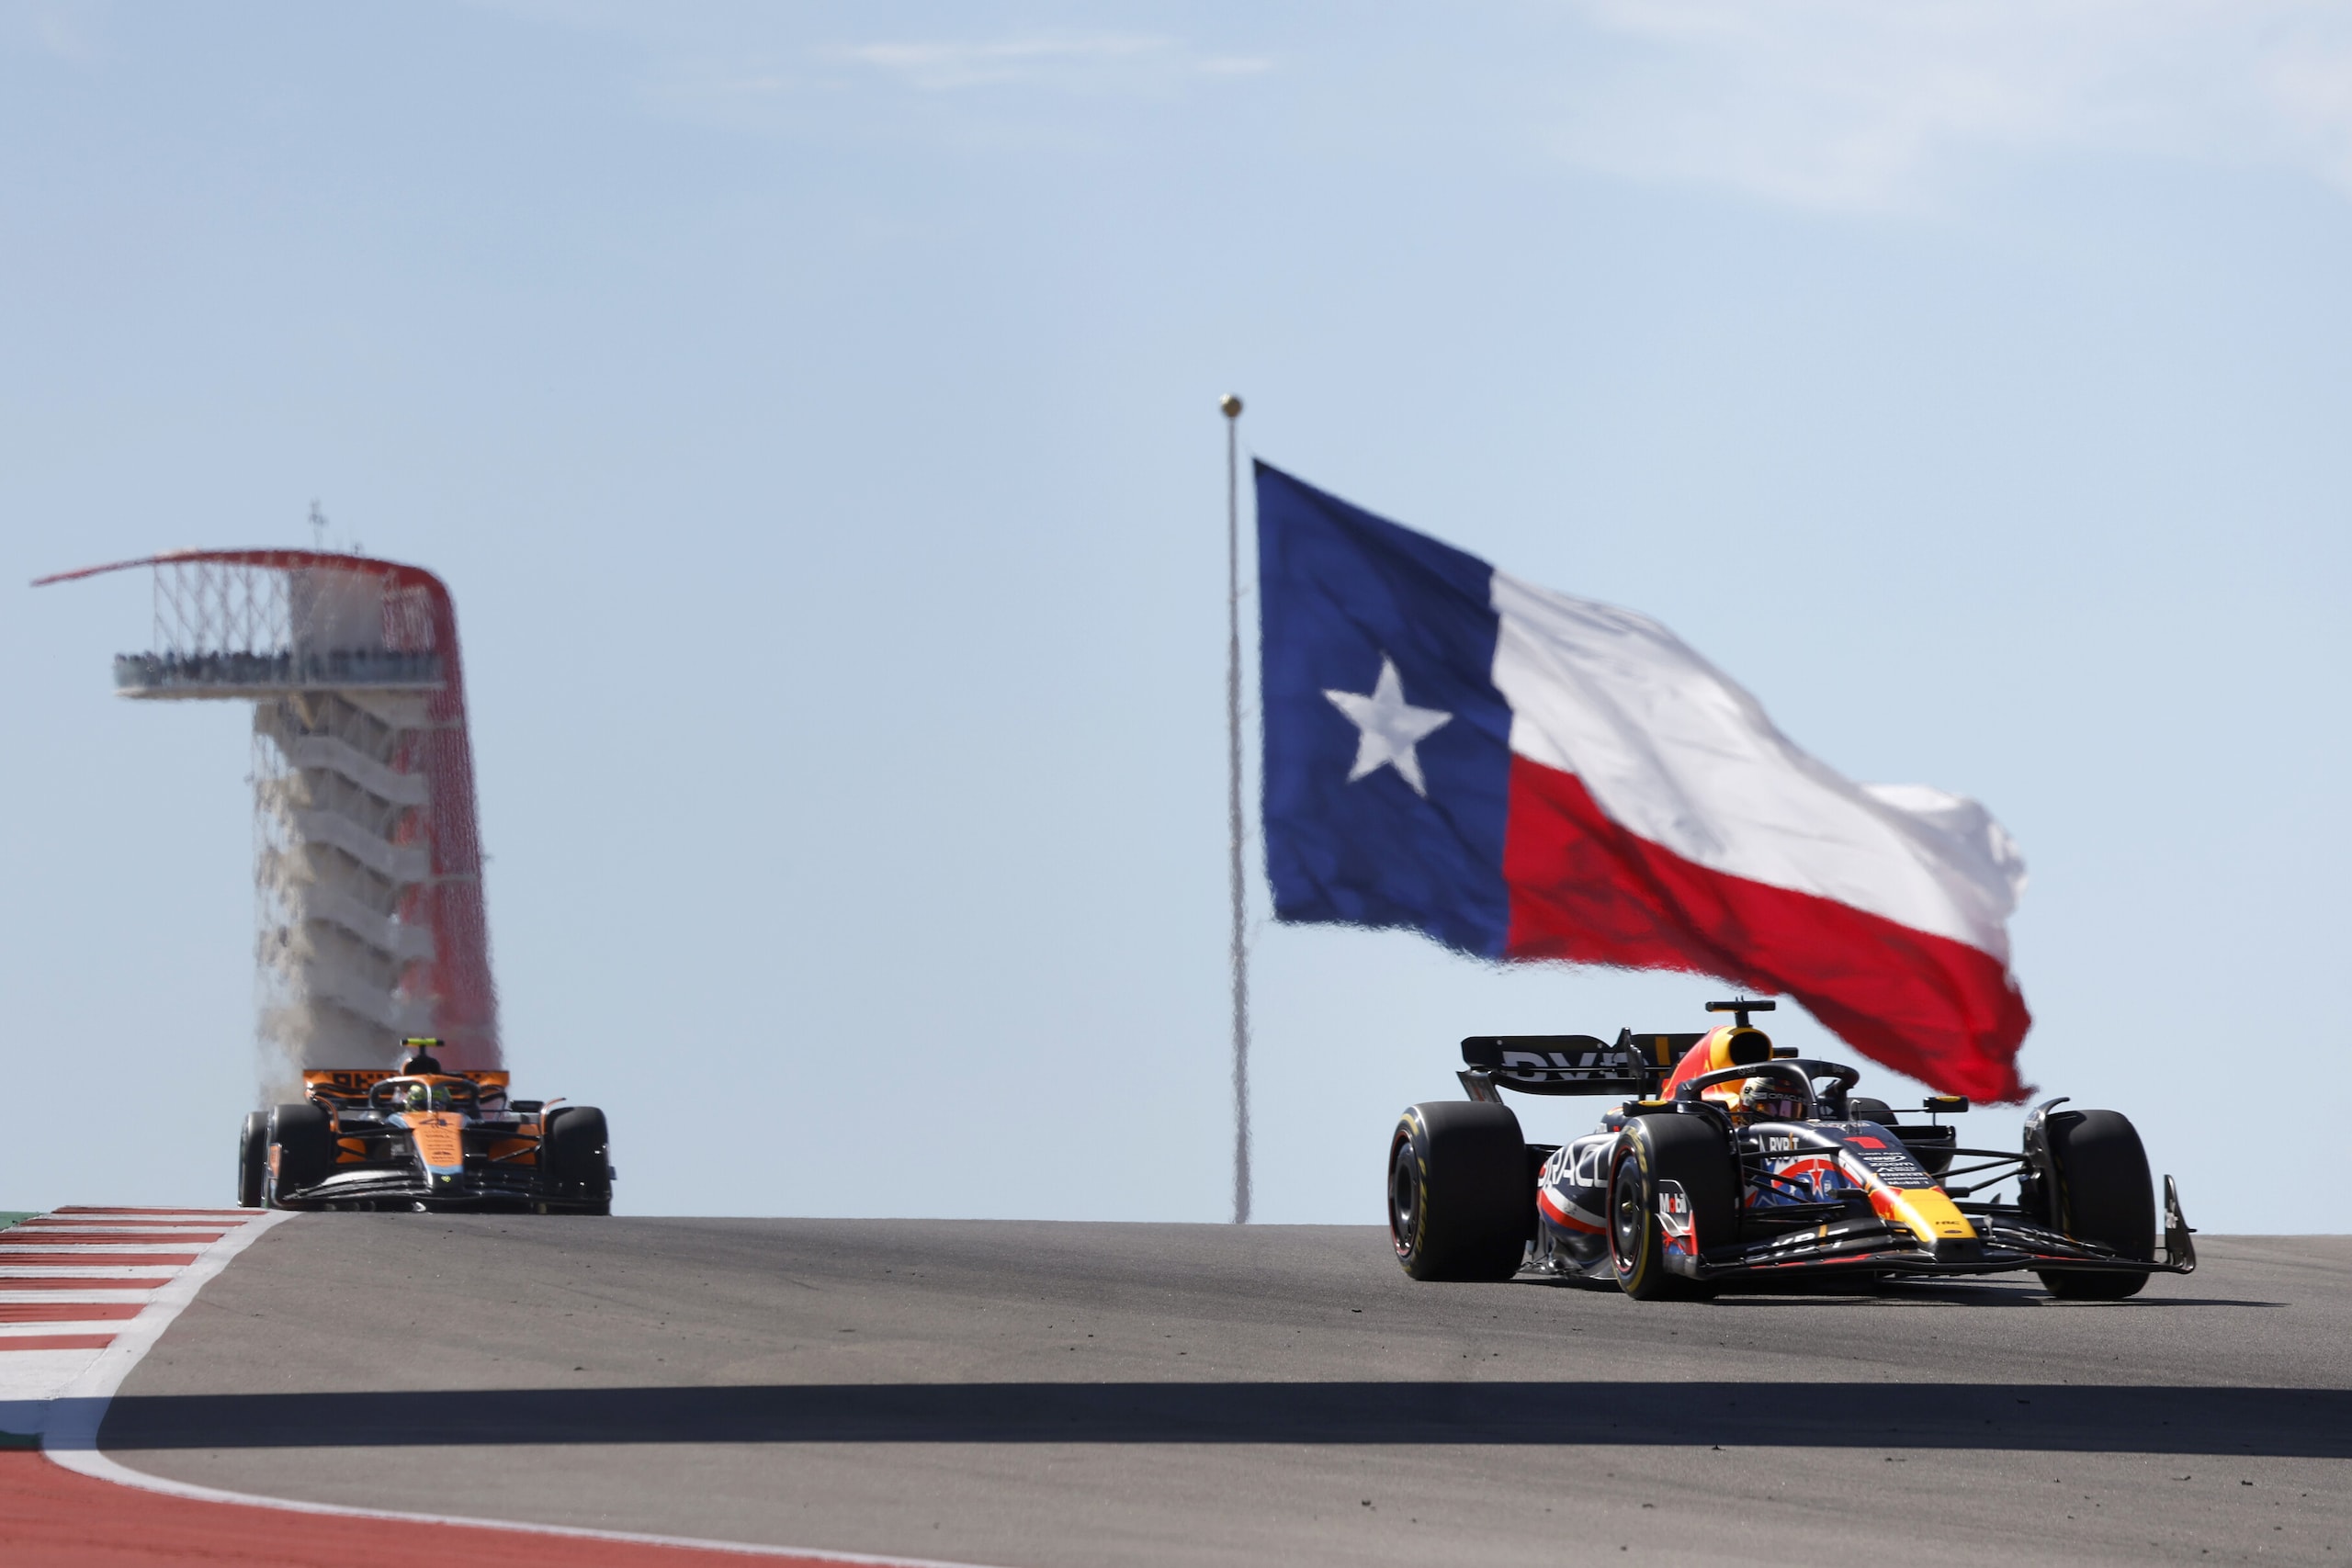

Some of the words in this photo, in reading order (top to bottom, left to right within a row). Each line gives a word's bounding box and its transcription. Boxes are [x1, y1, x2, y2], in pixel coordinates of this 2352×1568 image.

[1844, 1136, 1887, 1149] 1
[1537, 1142, 1614, 1188] ORACL
[1659, 1193, 1687, 1213] Mobil
